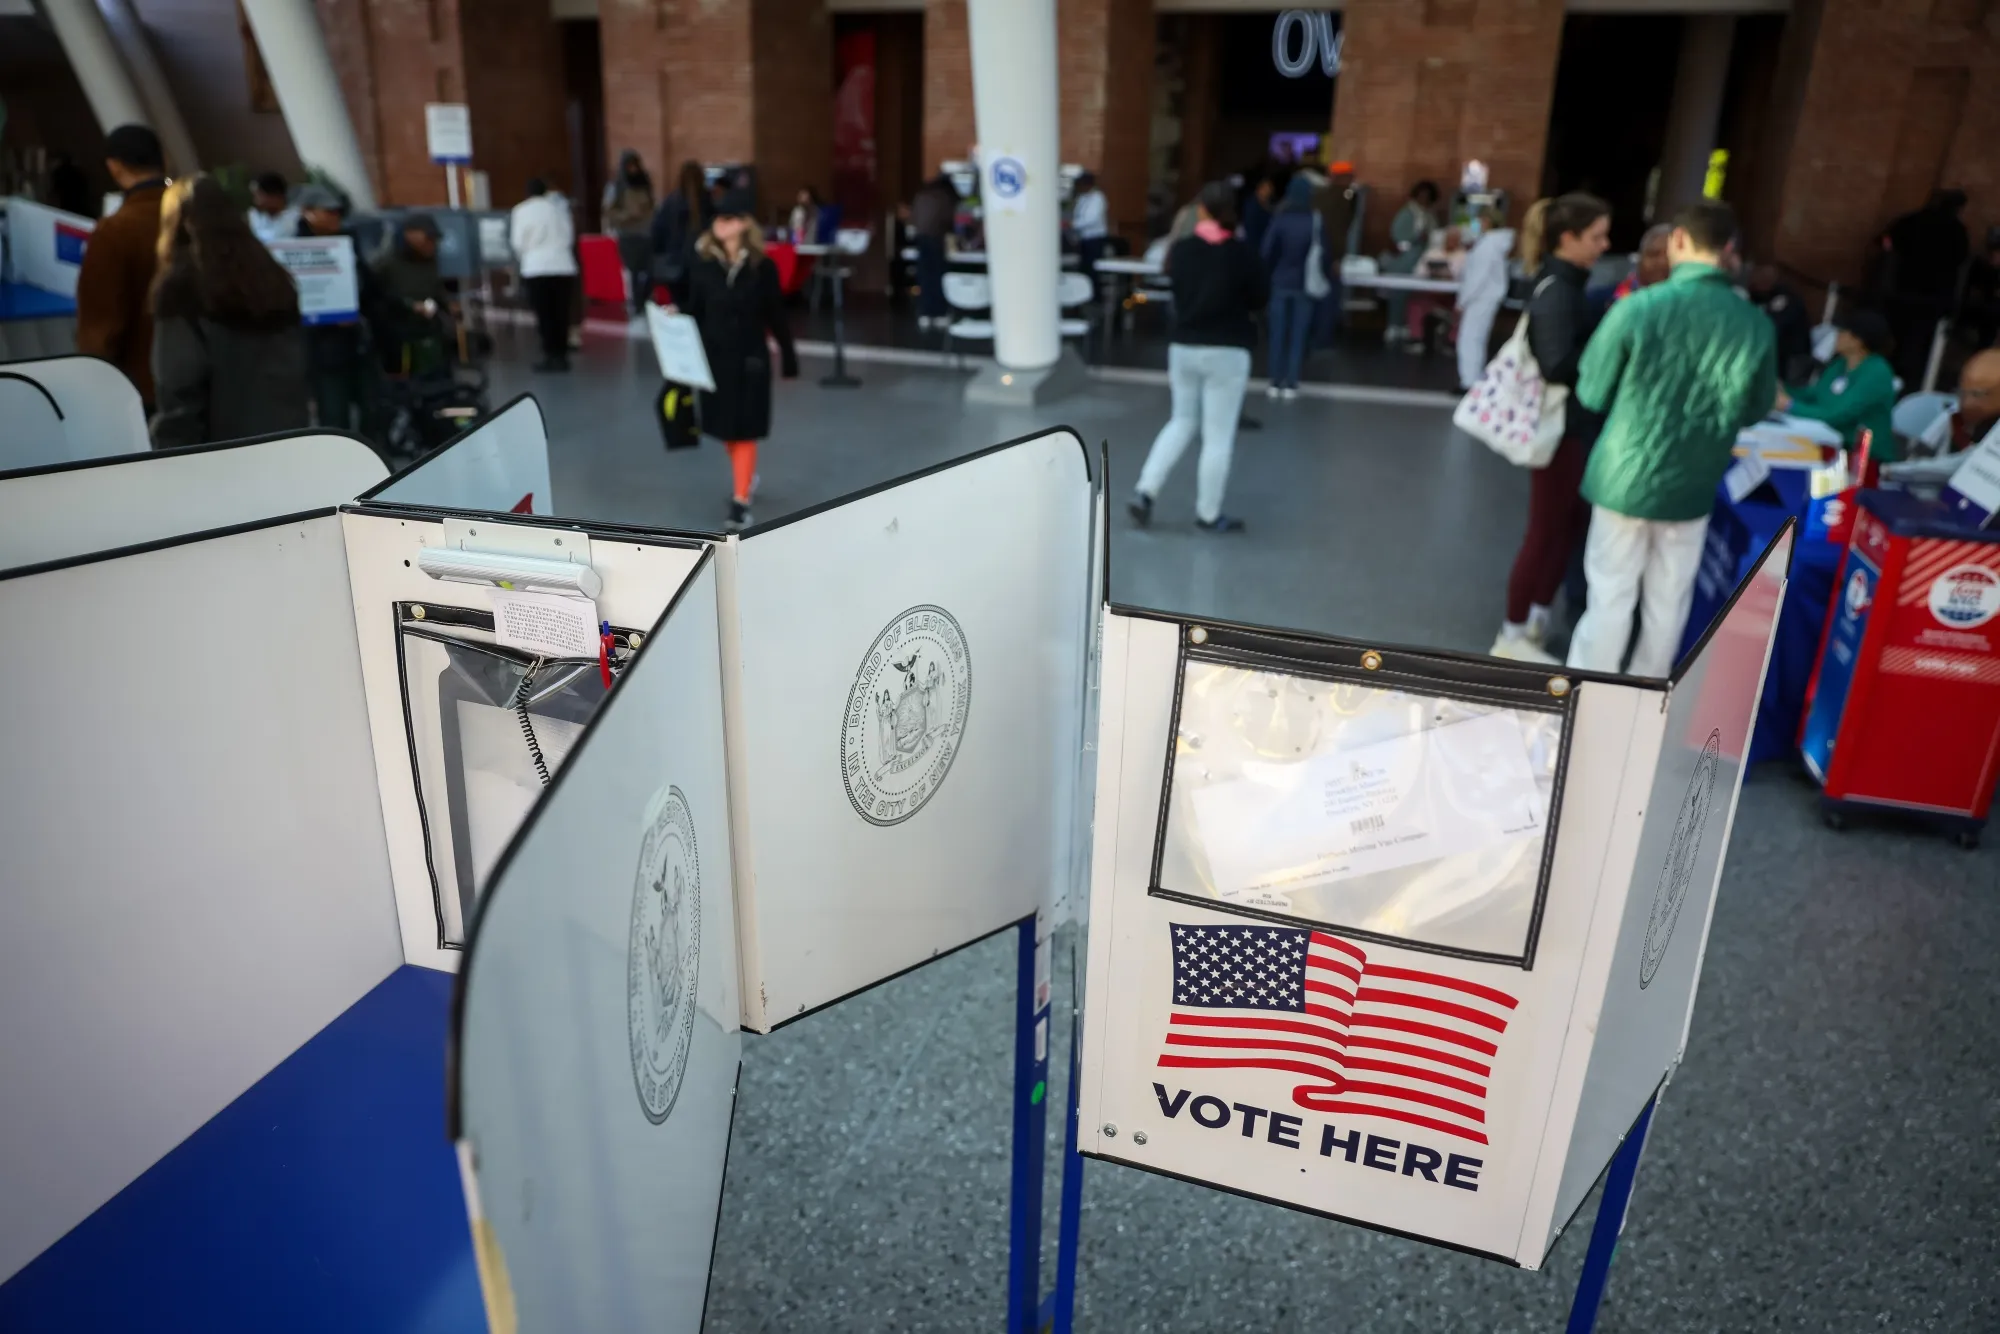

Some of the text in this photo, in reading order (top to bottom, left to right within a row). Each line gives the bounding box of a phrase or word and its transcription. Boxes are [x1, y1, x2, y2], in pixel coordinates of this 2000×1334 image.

[849, 615, 962, 727] BOARD OF ELECTIONS
[848, 678, 966, 816] IN THE CITY OF NEW YORK
[1152, 1082, 1484, 1192] VOTE HERE
